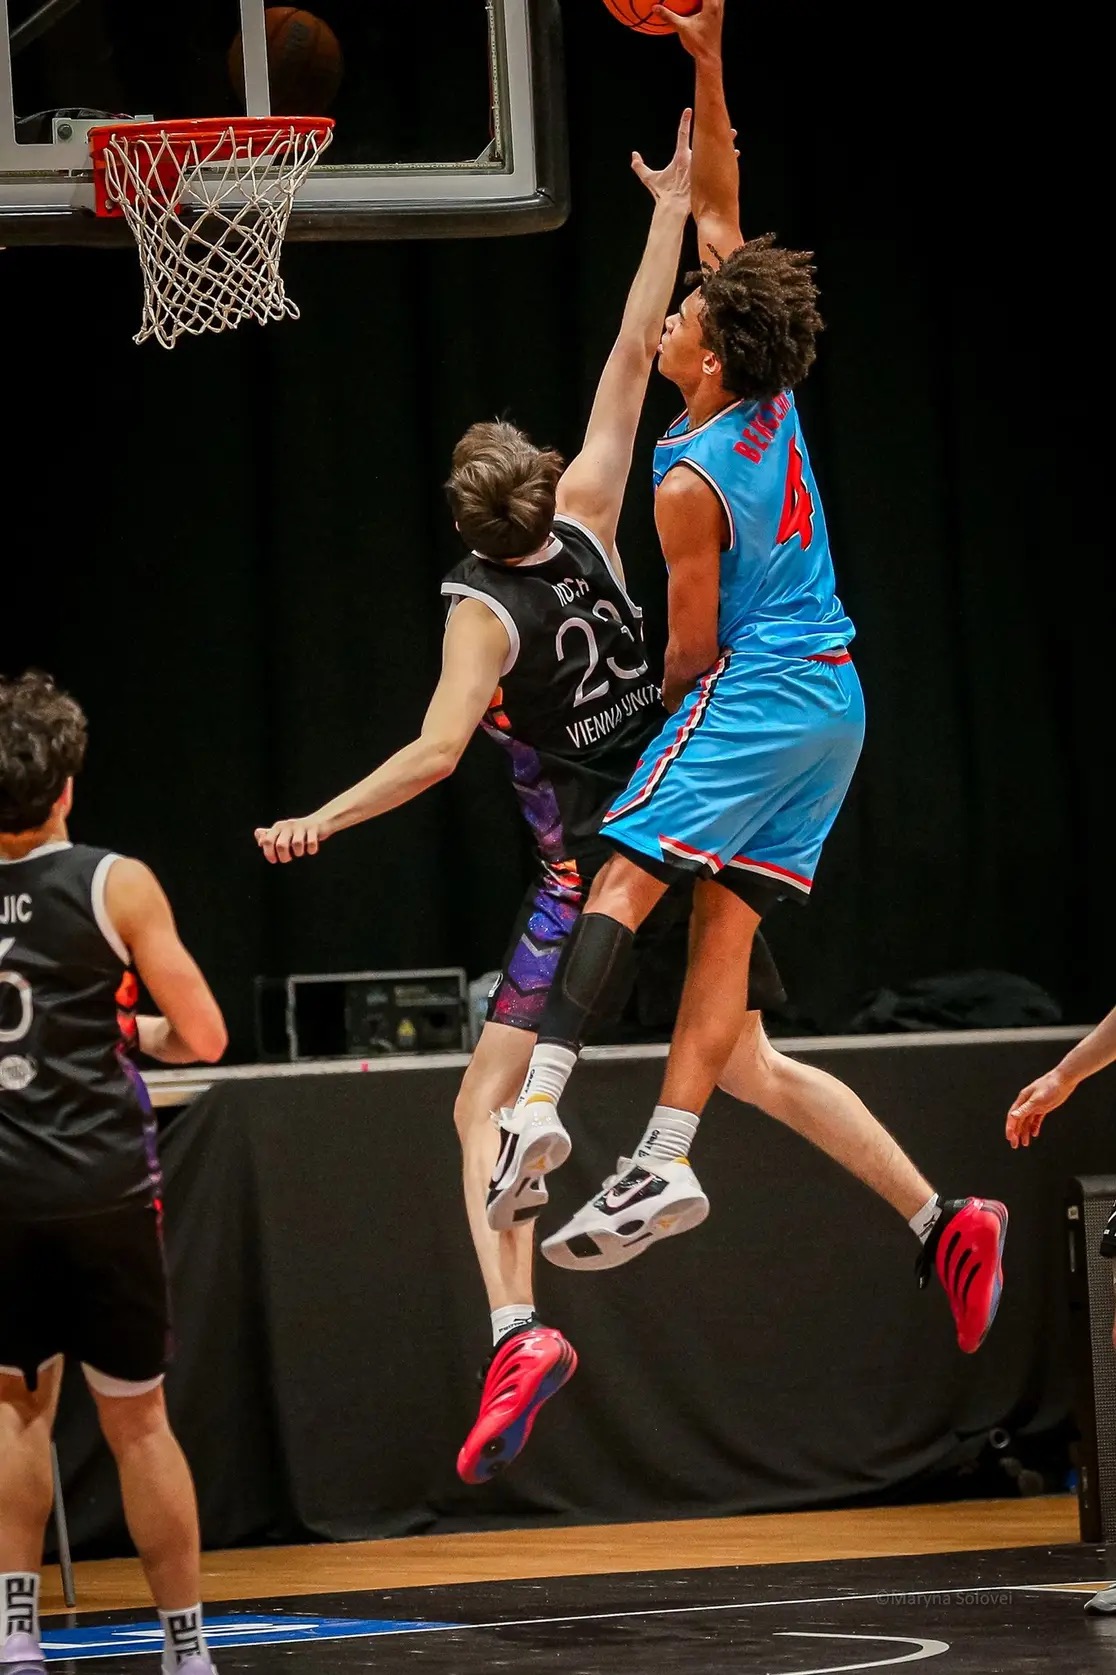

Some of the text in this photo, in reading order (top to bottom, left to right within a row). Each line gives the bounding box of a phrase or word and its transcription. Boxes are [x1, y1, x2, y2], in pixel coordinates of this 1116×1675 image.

[775, 435, 815, 552] 4
[555, 599, 649, 708] 23
[565, 703, 623, 749] VIENNA
